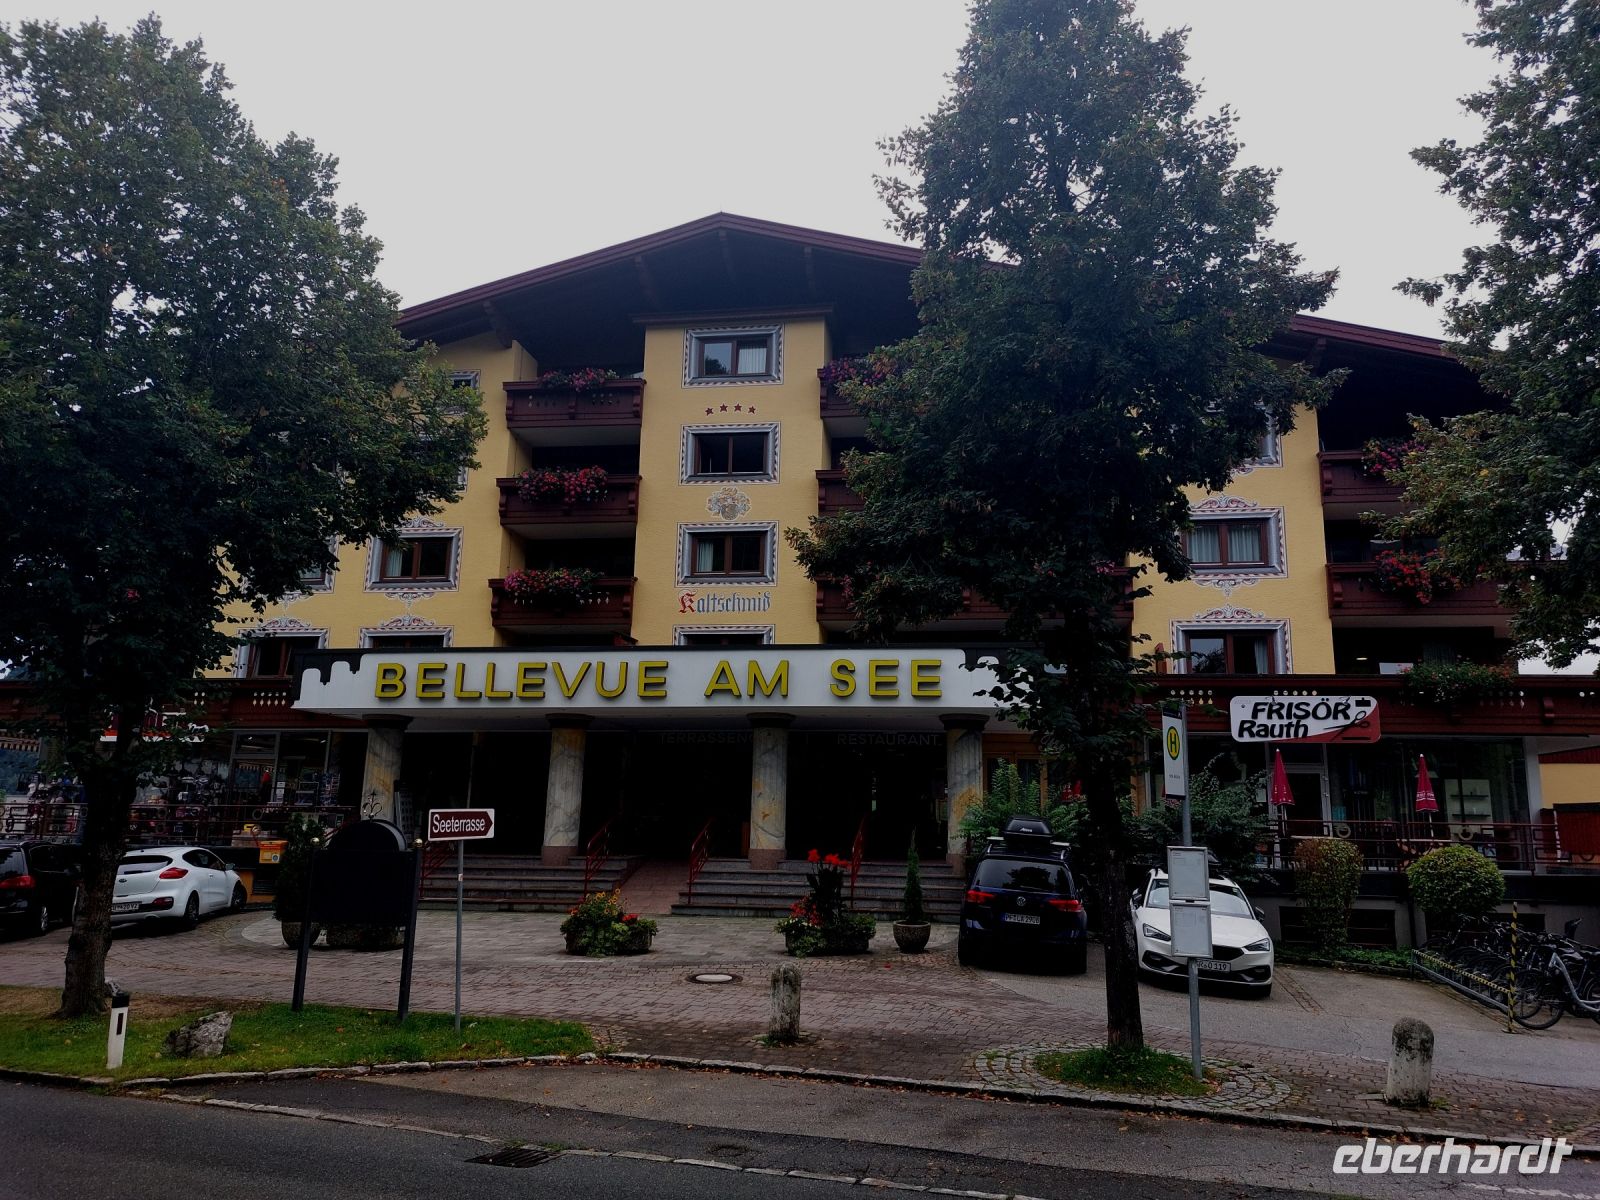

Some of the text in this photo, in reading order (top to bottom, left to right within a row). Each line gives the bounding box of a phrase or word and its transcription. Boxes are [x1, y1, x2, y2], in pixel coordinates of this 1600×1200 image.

[680, 590, 771, 613] Kaltschmid
[375, 659, 942, 699] BELLEVUE AM SEE
[1251, 698, 1351, 720] FRISÖR
[837, 733, 938, 745] RESTAURANT
[1238, 720, 1309, 738] Rauth
[1170, 732, 1177, 753] H
[432, 813, 486, 833] Seeterrasse
